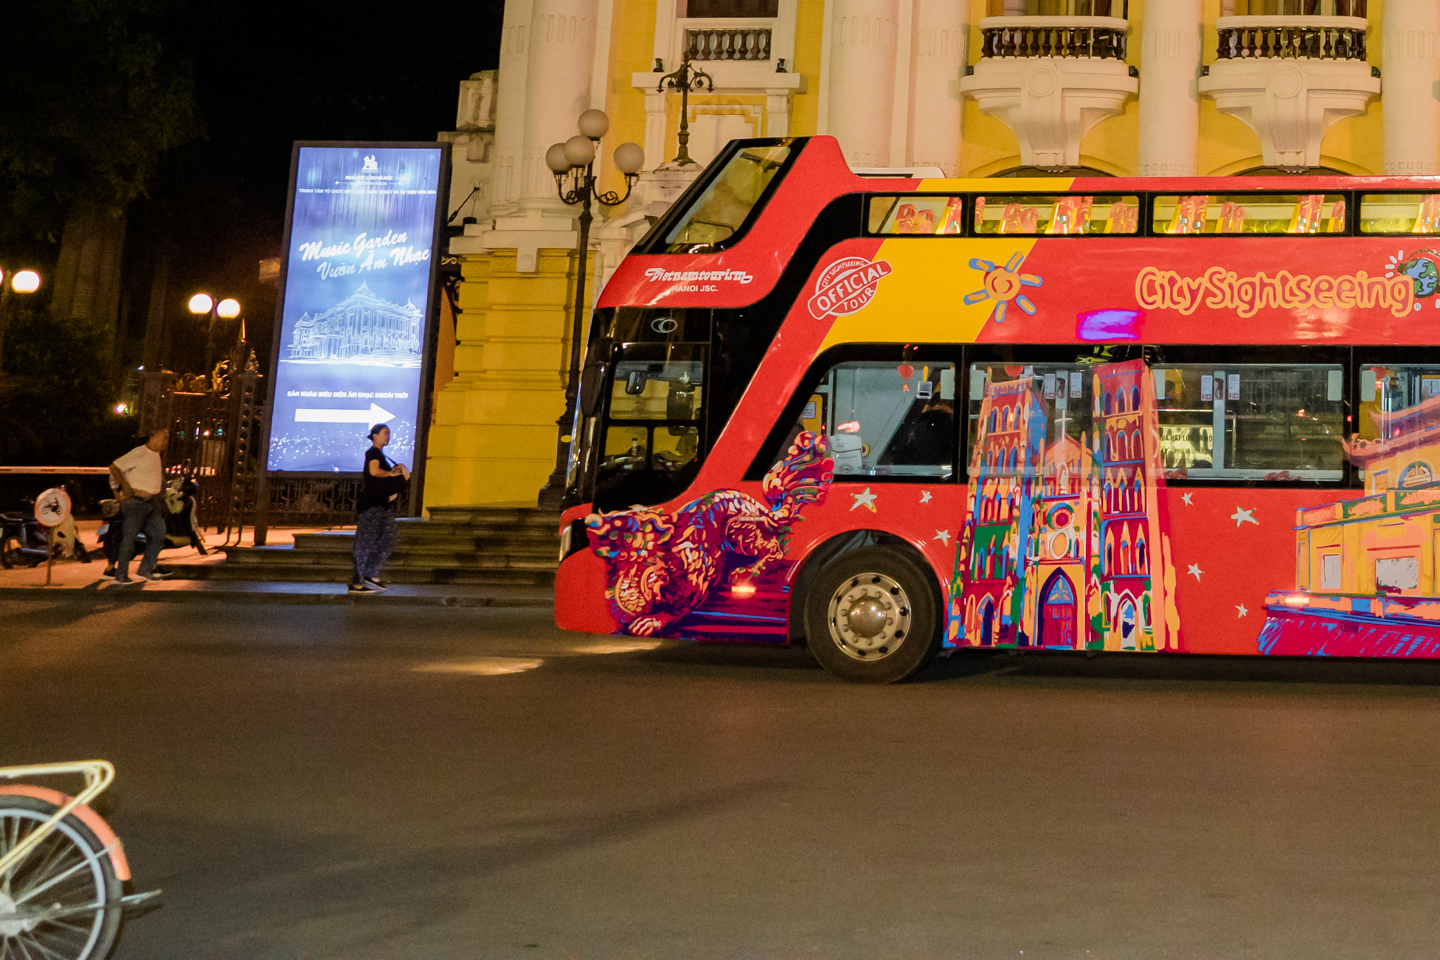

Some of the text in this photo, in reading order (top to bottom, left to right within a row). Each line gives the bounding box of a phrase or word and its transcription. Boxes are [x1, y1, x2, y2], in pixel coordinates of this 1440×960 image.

[299, 229, 408, 261] Music Garden
[358, 250, 388, 274] Âm
[389, 245, 430, 266] Nhạc
[644, 268, 753, 284] Vietnamtourism
[672, 284, 719, 292] HANOI JSC.
[816, 263, 888, 311] OFFICIAL
[821, 260, 866, 288] CITY SIGHTSEEING
[843, 287, 875, 311] TOUR
[1135, 266, 1414, 318] CitySightseeing
